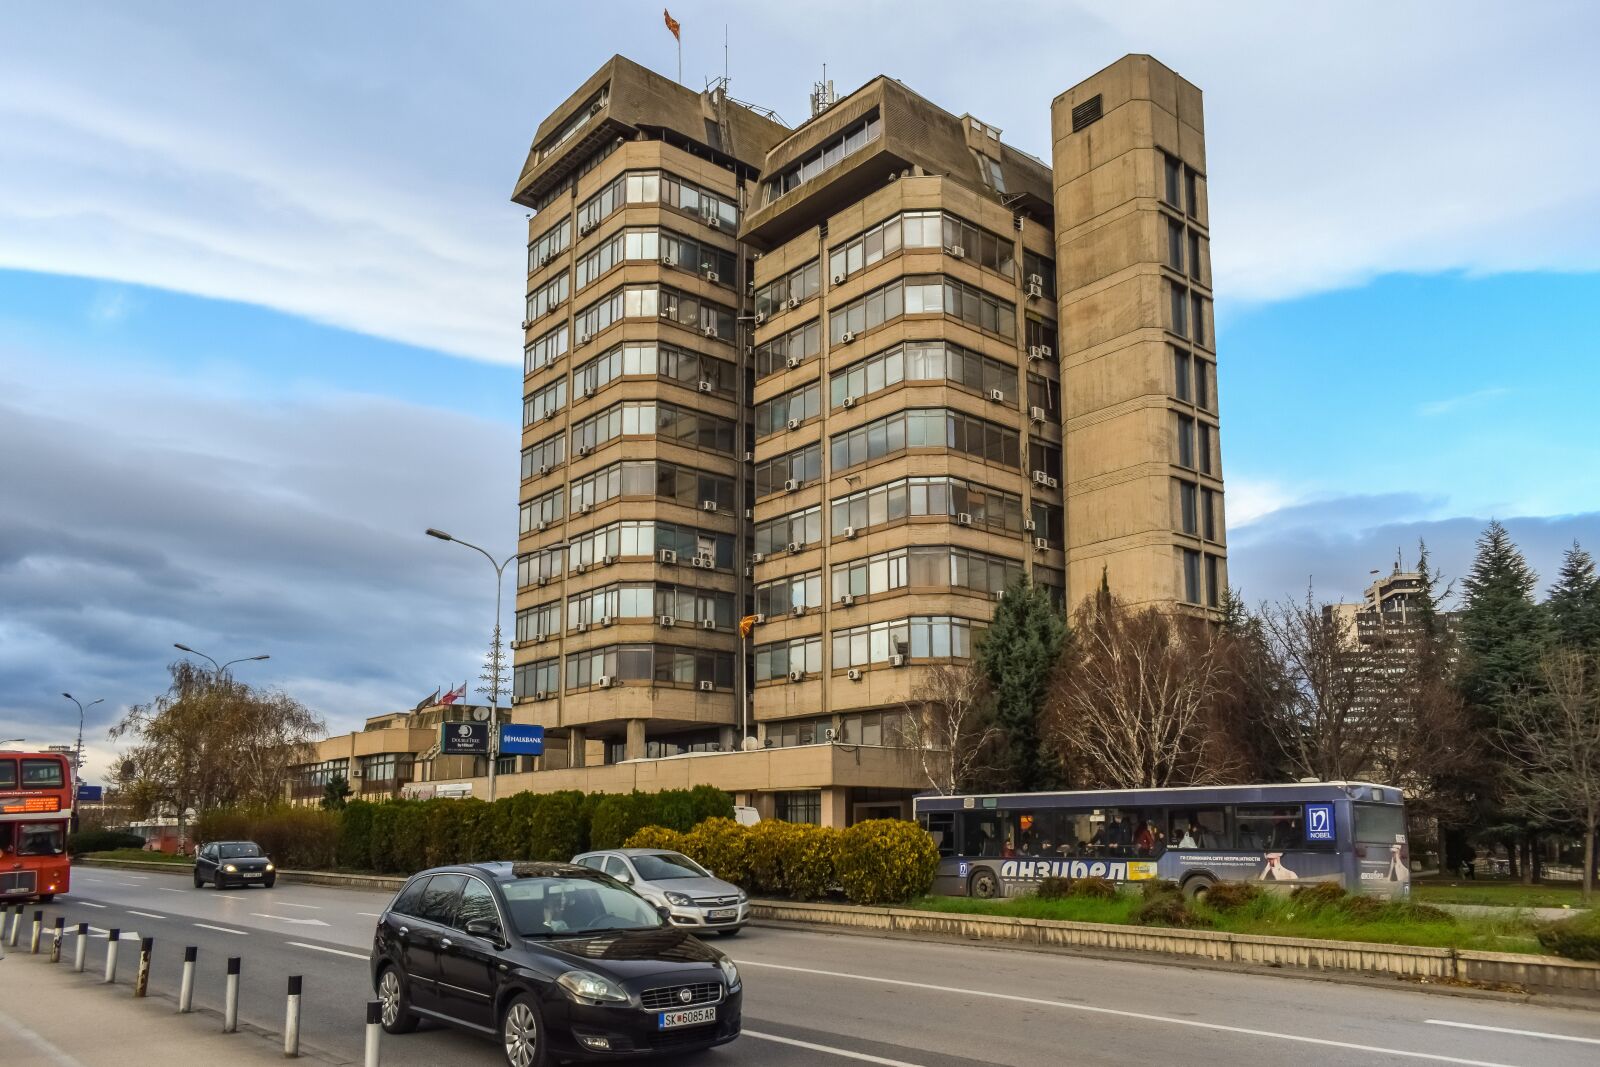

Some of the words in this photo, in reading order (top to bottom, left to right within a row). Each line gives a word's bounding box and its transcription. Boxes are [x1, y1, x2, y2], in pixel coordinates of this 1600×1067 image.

[510, 736, 542, 744] HALKBANK
[666, 1014, 676, 1025] SK
[683, 1011, 703, 1023] 6085
[705, 1009, 714, 1020] AR
